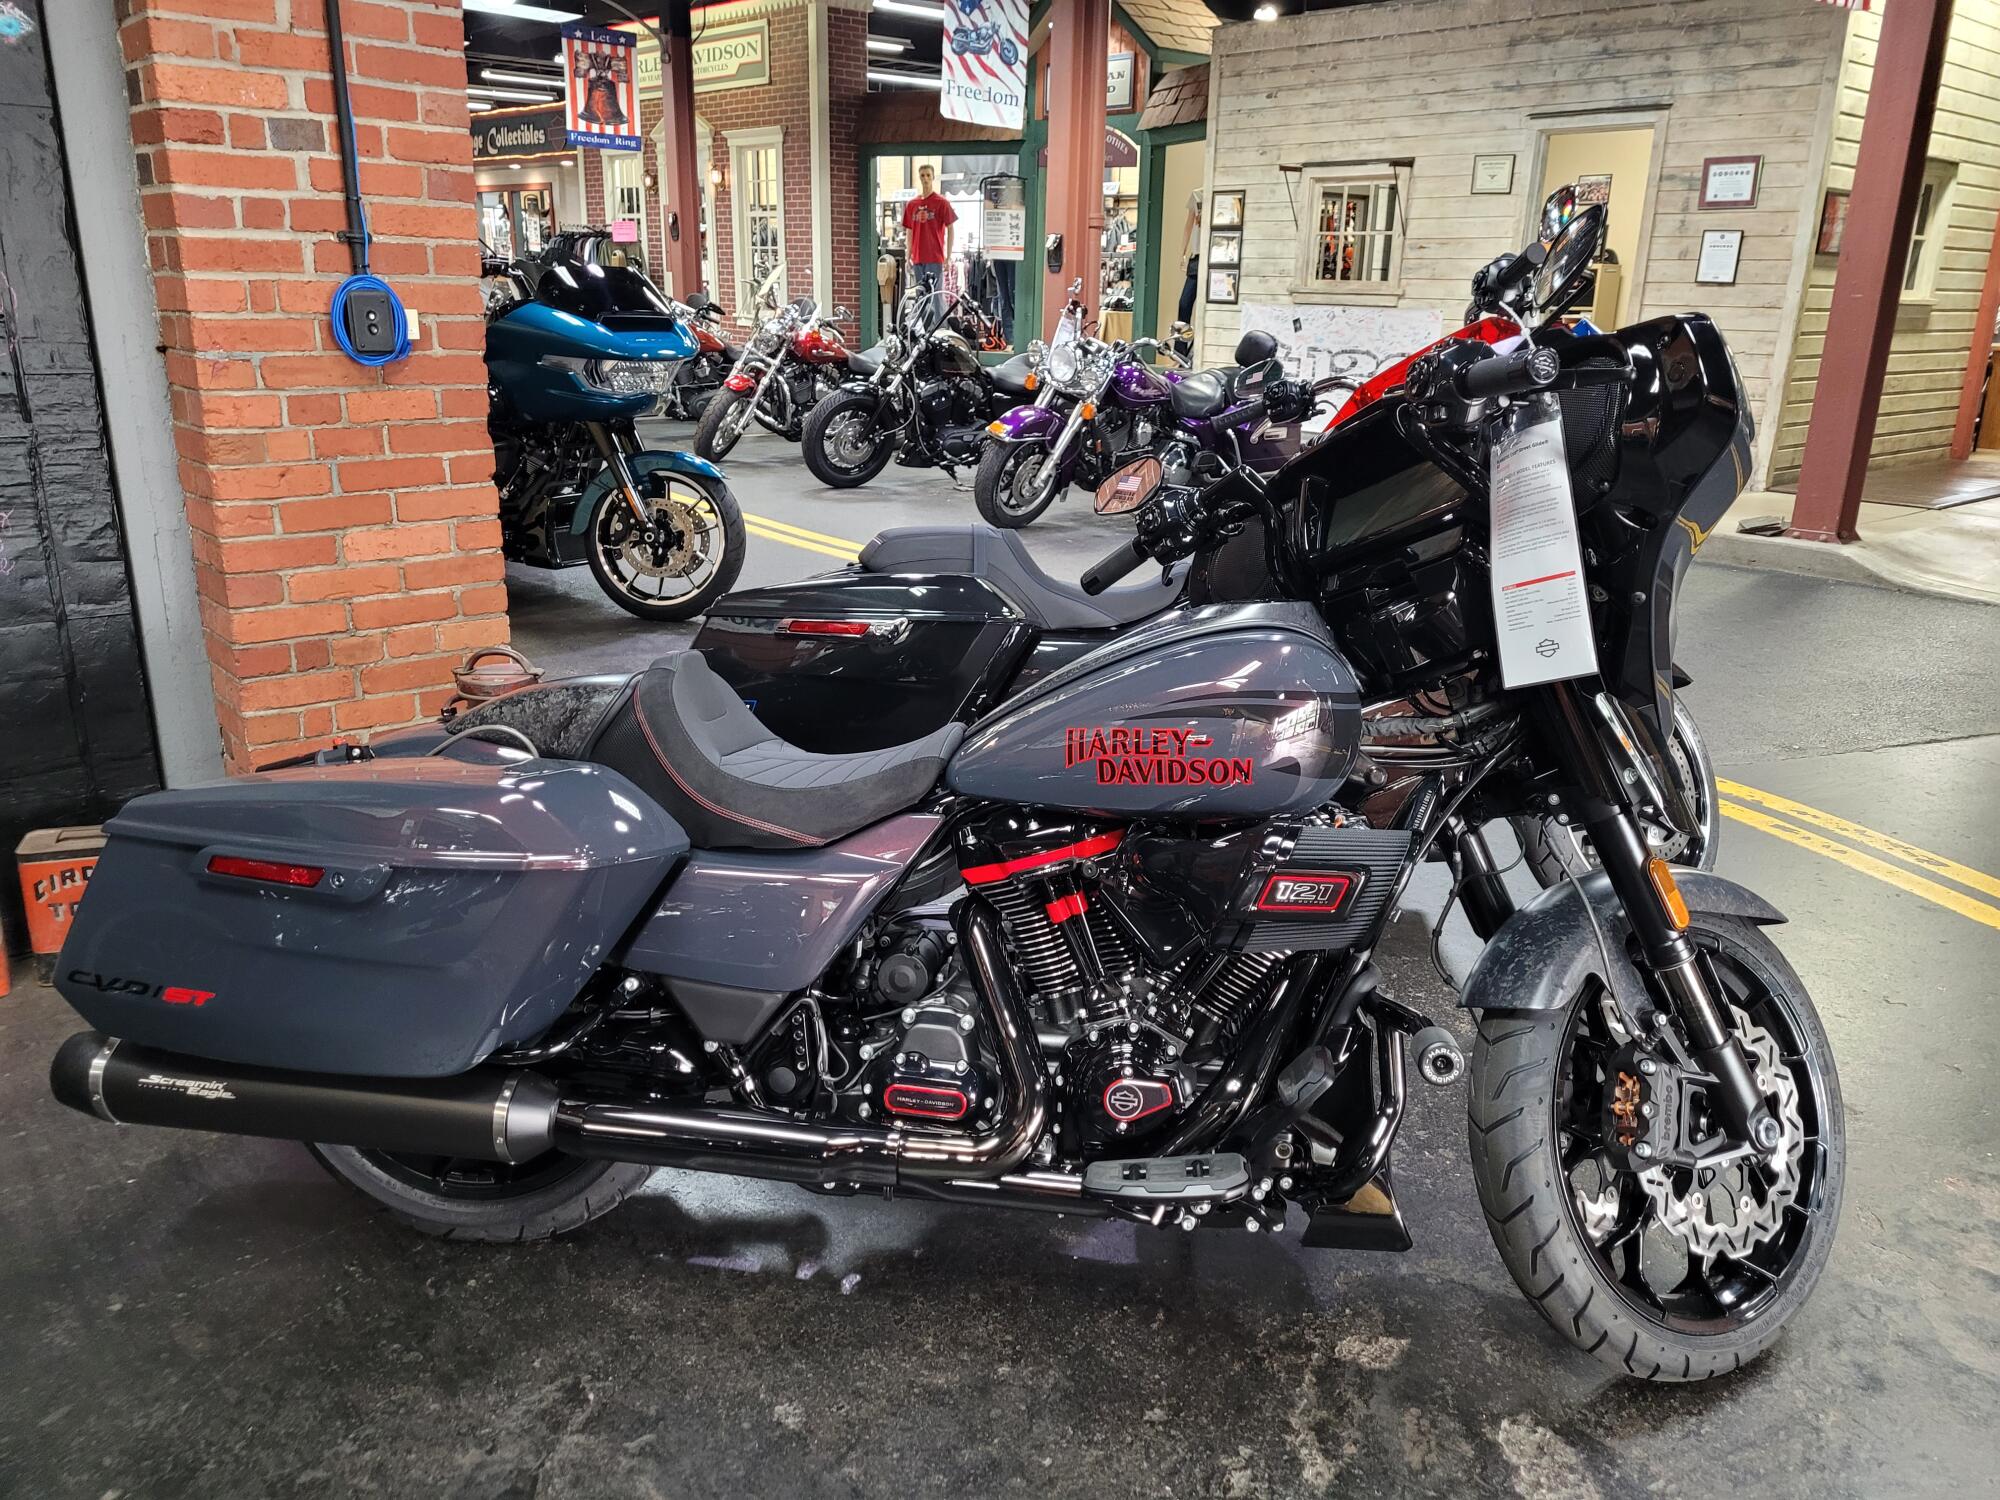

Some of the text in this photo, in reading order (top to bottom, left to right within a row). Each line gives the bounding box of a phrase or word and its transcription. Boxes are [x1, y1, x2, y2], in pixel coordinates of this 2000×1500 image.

[591, 30, 611, 42] Let
[946, 79, 1020, 107] Freedom
[487, 123, 546, 154] Collectibles
[570, 132, 637, 147] Freedom Ring
[1097, 757, 1254, 785] DAVIDSON
[1277, 881, 1334, 900] 121
[186, 1086, 236, 1099] Eagle
[1661, 1084, 1673, 1141] brembo
